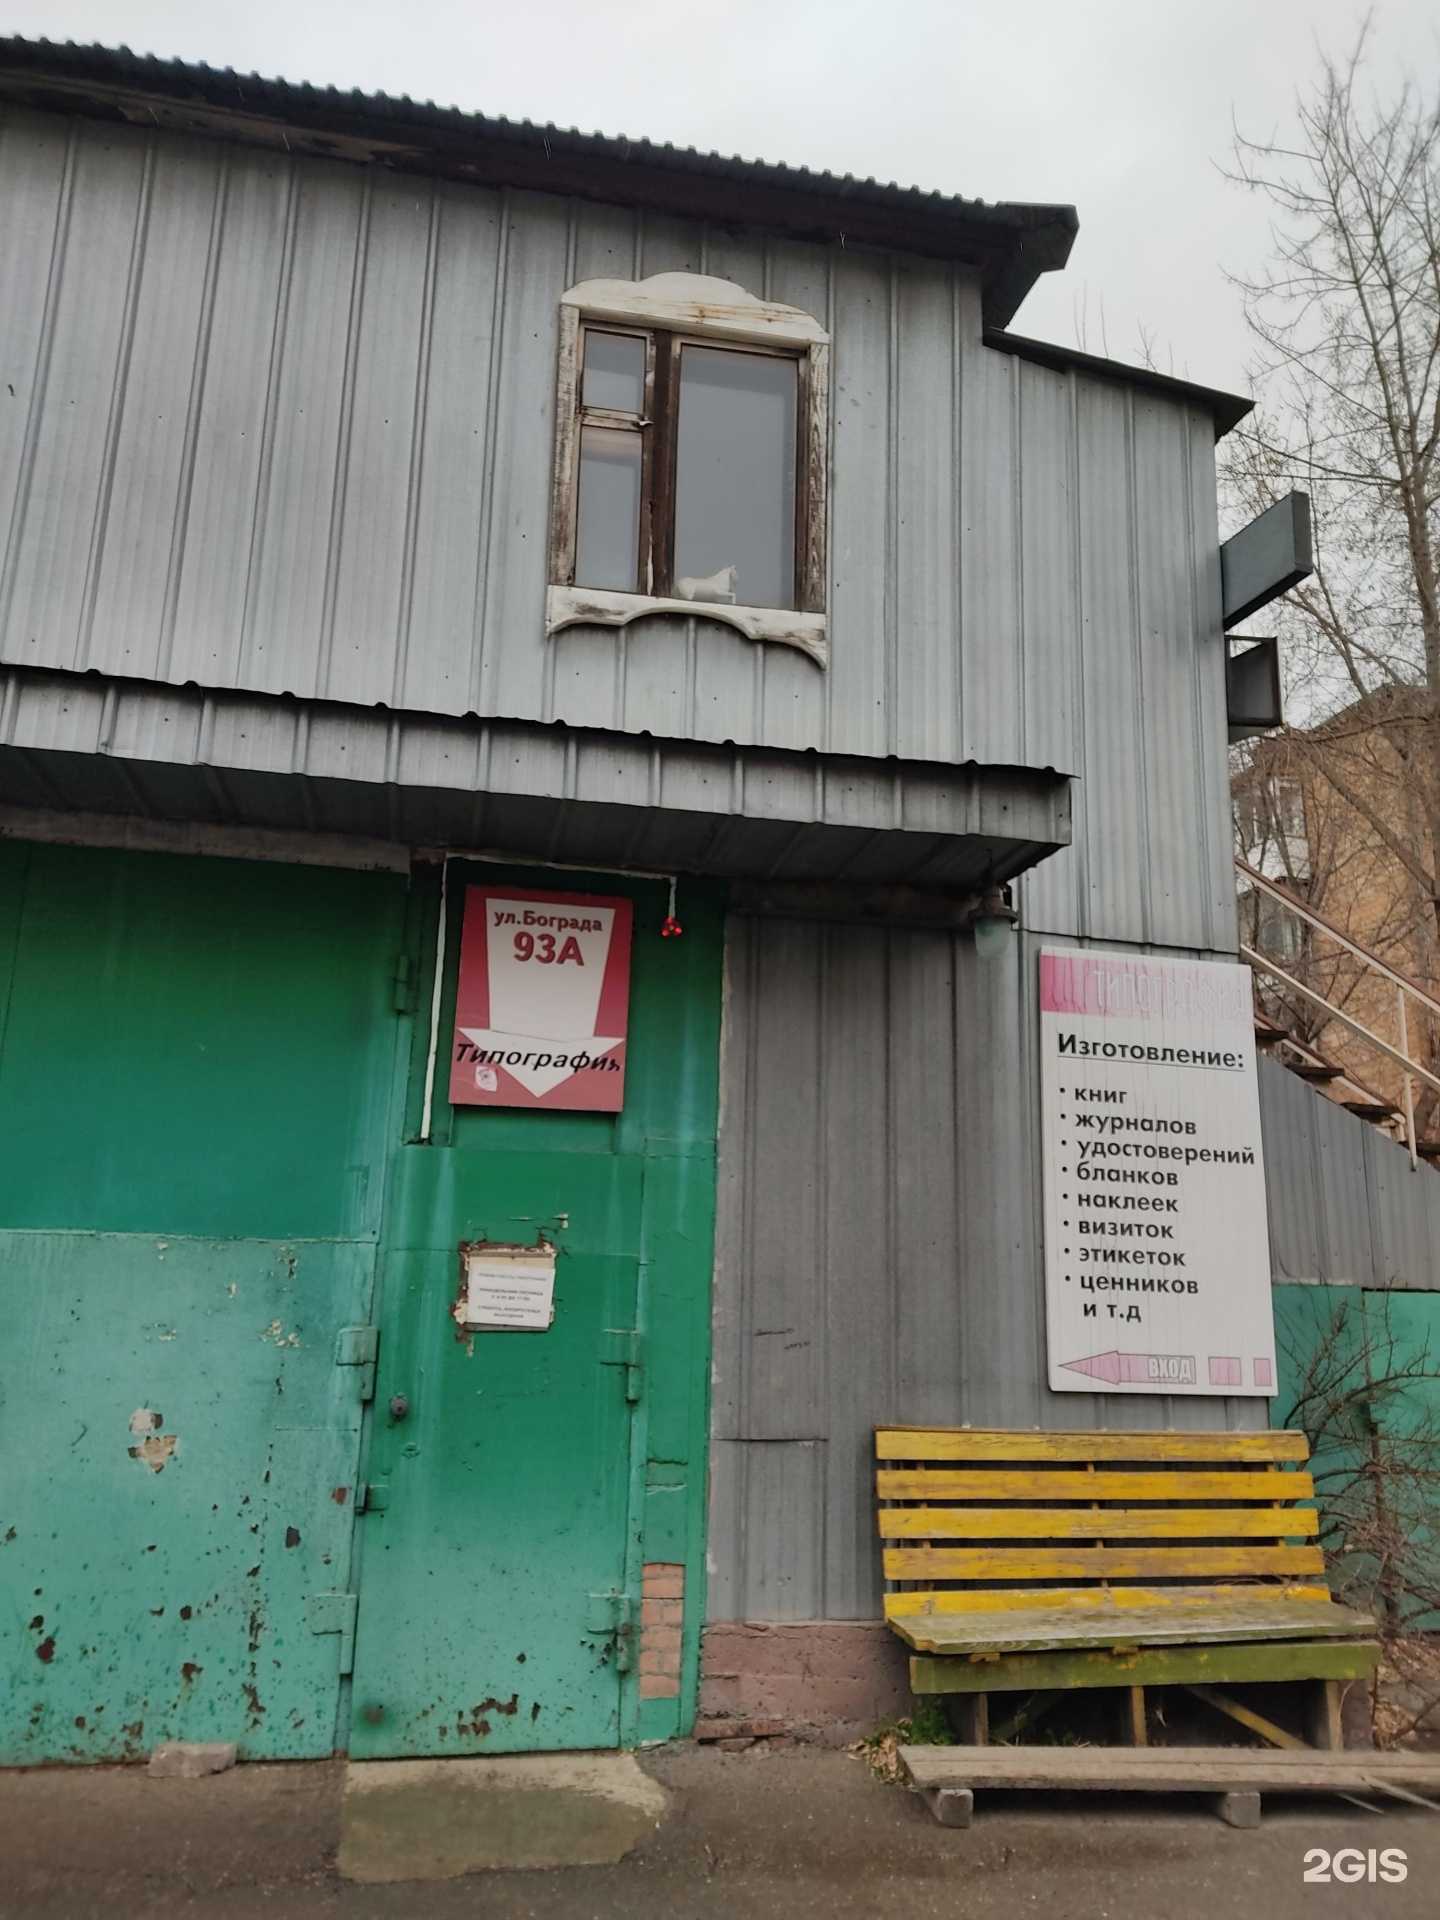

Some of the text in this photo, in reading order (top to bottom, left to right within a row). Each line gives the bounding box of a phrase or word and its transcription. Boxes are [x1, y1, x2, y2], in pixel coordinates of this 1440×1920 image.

[513, 931, 584, 967] 93А
[1058, 1033, 1244, 1068] Изготовление:
[1074, 1087, 1127, 1104] книг
[1075, 1113, 1197, 1135] журналов
[1077, 1140, 1255, 1166] удостоверений
[1077, 1161, 1178, 1186] бланков
[1077, 1192, 1178, 1212] наклеек
[1078, 1220, 1174, 1239] визиток
[1079, 1247, 1186, 1266] этикеток
[1080, 1275, 1199, 1295] ценников
[1083, 1303, 1142, 1323] и т.д
[1148, 1358, 1194, 1383] ВХОД
